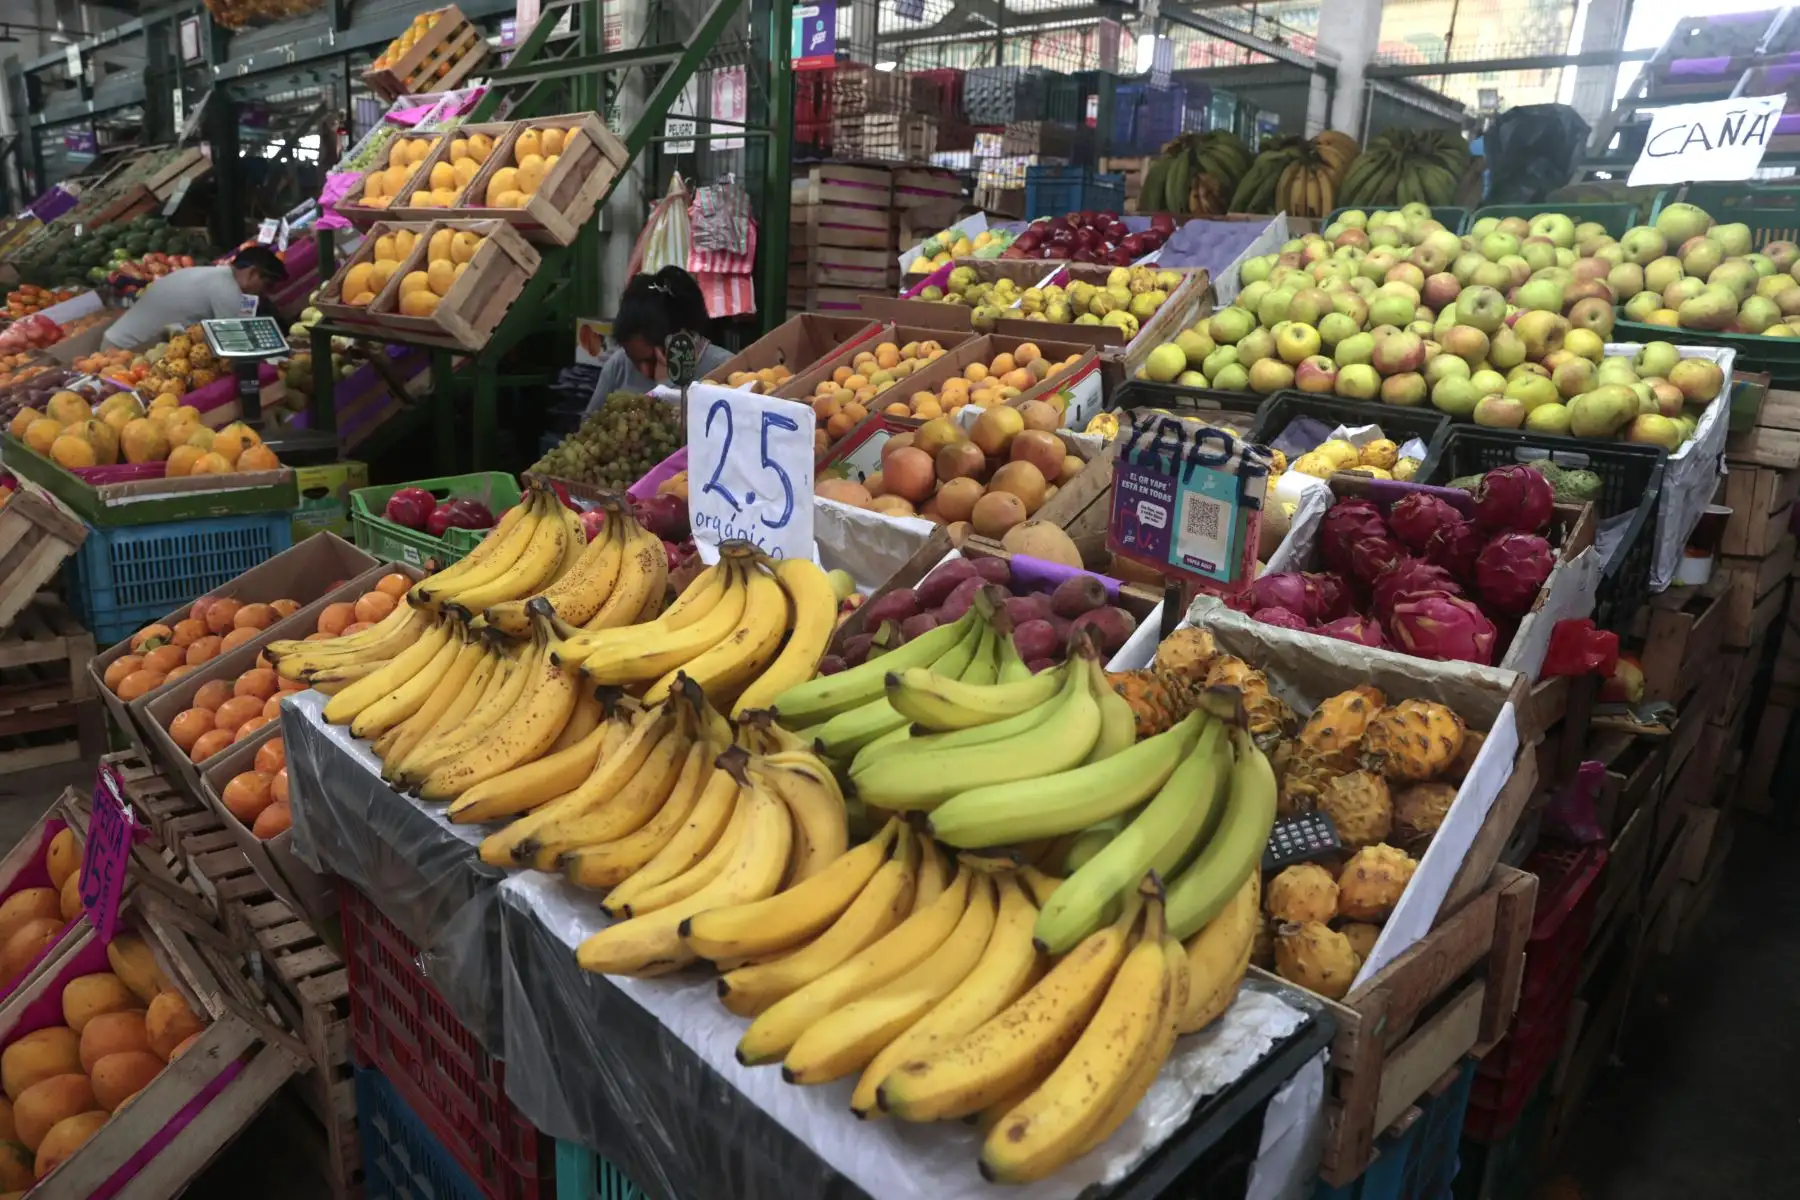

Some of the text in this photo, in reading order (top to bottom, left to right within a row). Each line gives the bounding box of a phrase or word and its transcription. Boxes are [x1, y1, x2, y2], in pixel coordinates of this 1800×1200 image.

[1647, 109, 1771, 157] CAÑA
[702, 399, 799, 529] 2.5
[1120, 410, 1273, 510] YAPE
[1129, 472, 1168, 491] EL QR YAPE
[1139, 486, 1148, 494] EN
[1149, 488, 1173, 503] TODAS
